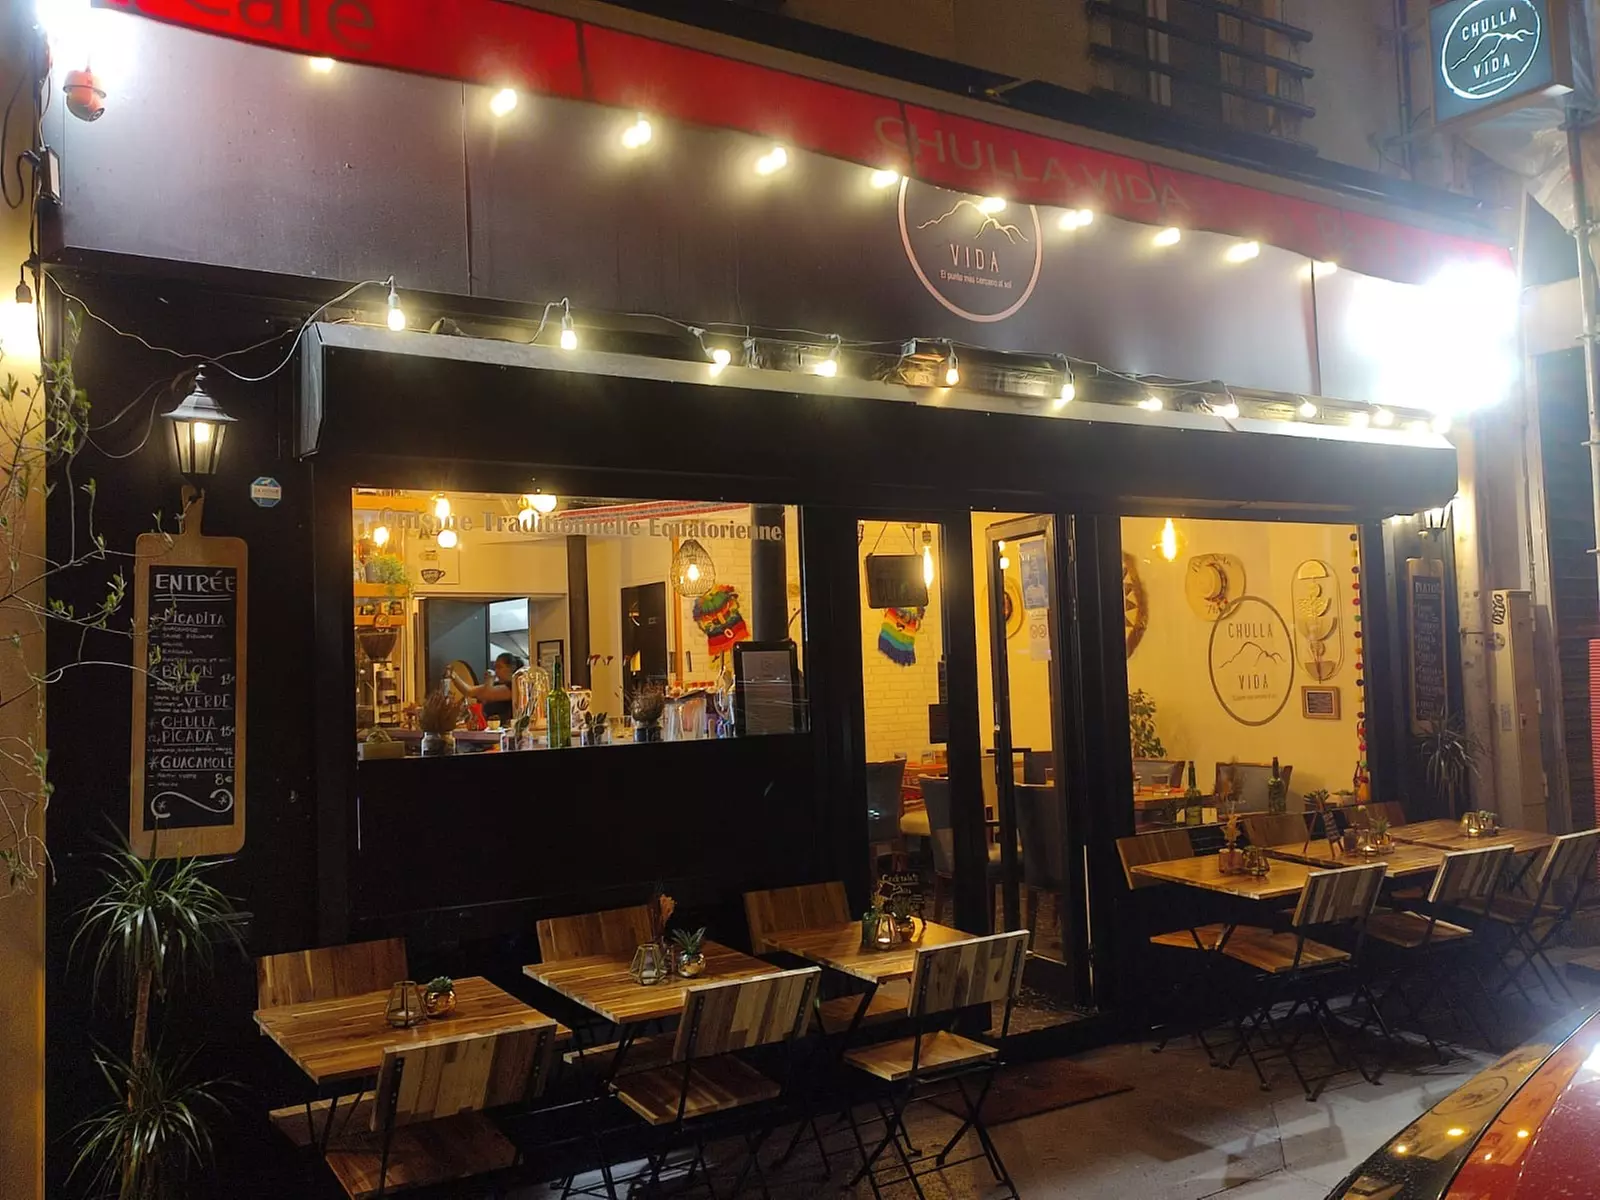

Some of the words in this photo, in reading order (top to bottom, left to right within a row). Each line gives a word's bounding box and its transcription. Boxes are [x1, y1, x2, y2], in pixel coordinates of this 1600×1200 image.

[1462, 7, 1517, 41] CHULLA
[1473, 53, 1511, 78] VIDA
[874, 116, 1066, 185] CHULLA
[1078, 162, 1190, 211] VIDA
[949, 243, 999, 272] VIDA
[155, 570, 237, 594] ENTRÉE
[1228, 622, 1274, 639] CHULLA
[1238, 673, 1269, 690] VIDA
[184, 694, 231, 709] VERDE
[161, 716, 217, 728] CHULLA
[162, 729, 214, 744] PICADA
